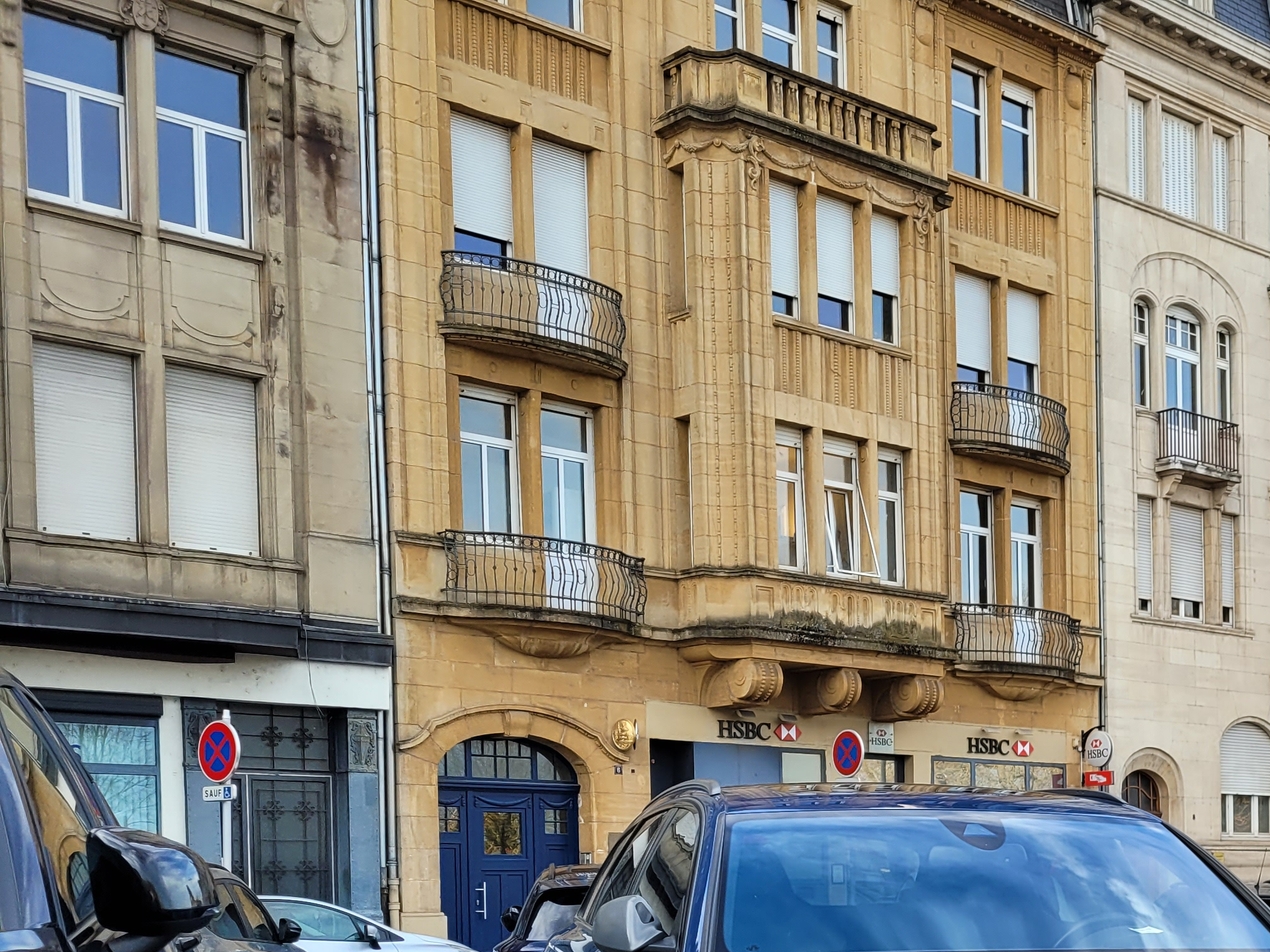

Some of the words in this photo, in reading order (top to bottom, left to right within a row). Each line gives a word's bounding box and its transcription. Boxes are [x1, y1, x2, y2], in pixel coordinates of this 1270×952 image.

[717, 720, 771, 740] HSBC
[871, 737, 893, 746] HSBC
[967, 737, 1010, 755] HSBC
[1087, 748, 1109, 759] HSBC
[205, 789, 222, 798] SAUF
